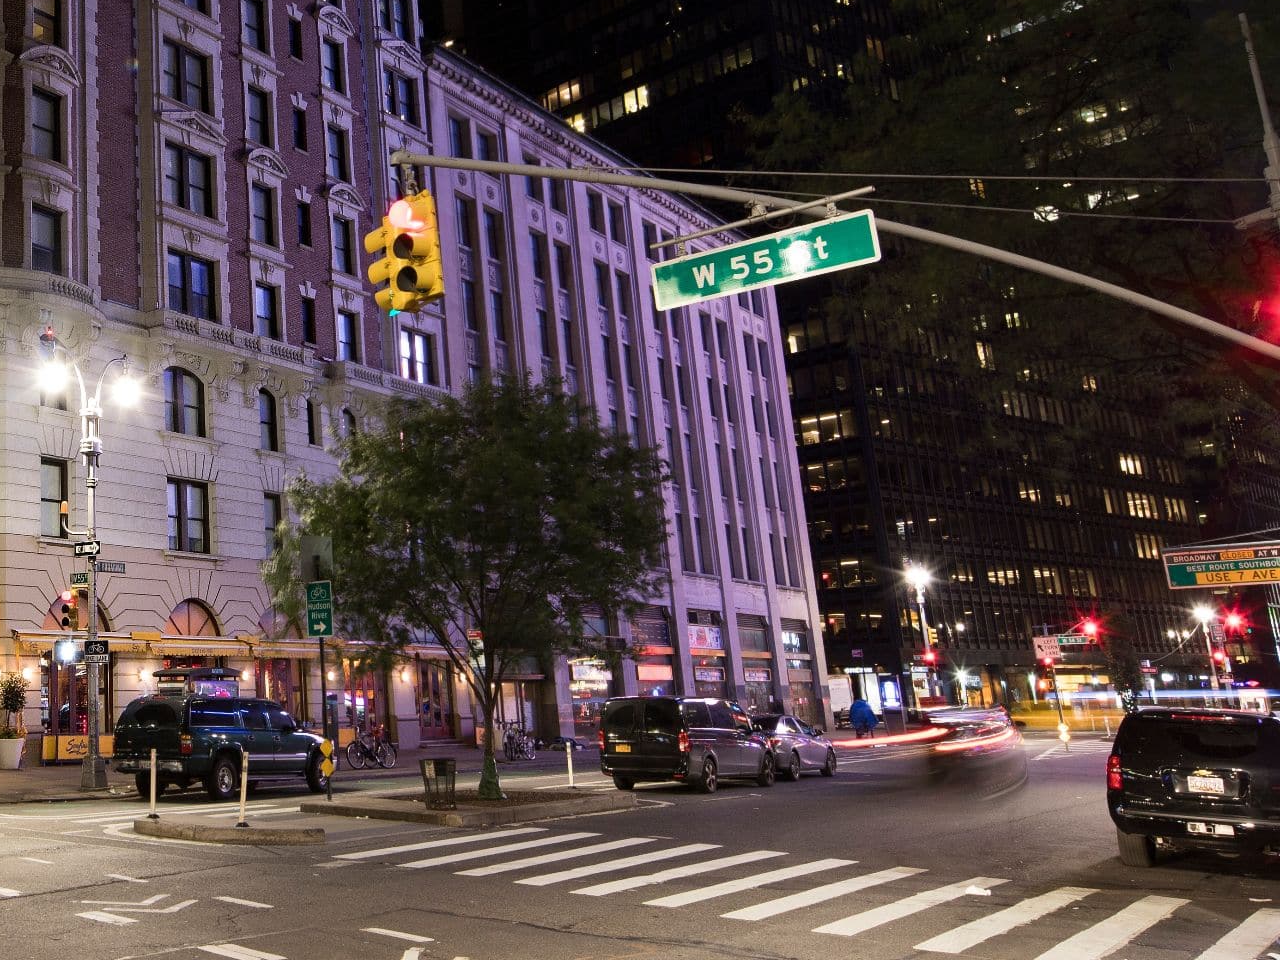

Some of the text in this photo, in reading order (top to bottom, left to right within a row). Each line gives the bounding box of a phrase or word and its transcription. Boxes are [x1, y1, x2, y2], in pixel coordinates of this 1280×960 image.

[692, 263, 715, 289] W
[730, 249, 773, 280] 55
[1173, 553, 1217, 563] BROADWAY
[1209, 562, 1235, 571] ROUTE
[1205, 570, 1278, 582] USE 7 AVE
[308, 602, 330, 610] Hudson
[312, 611, 328, 620] River
